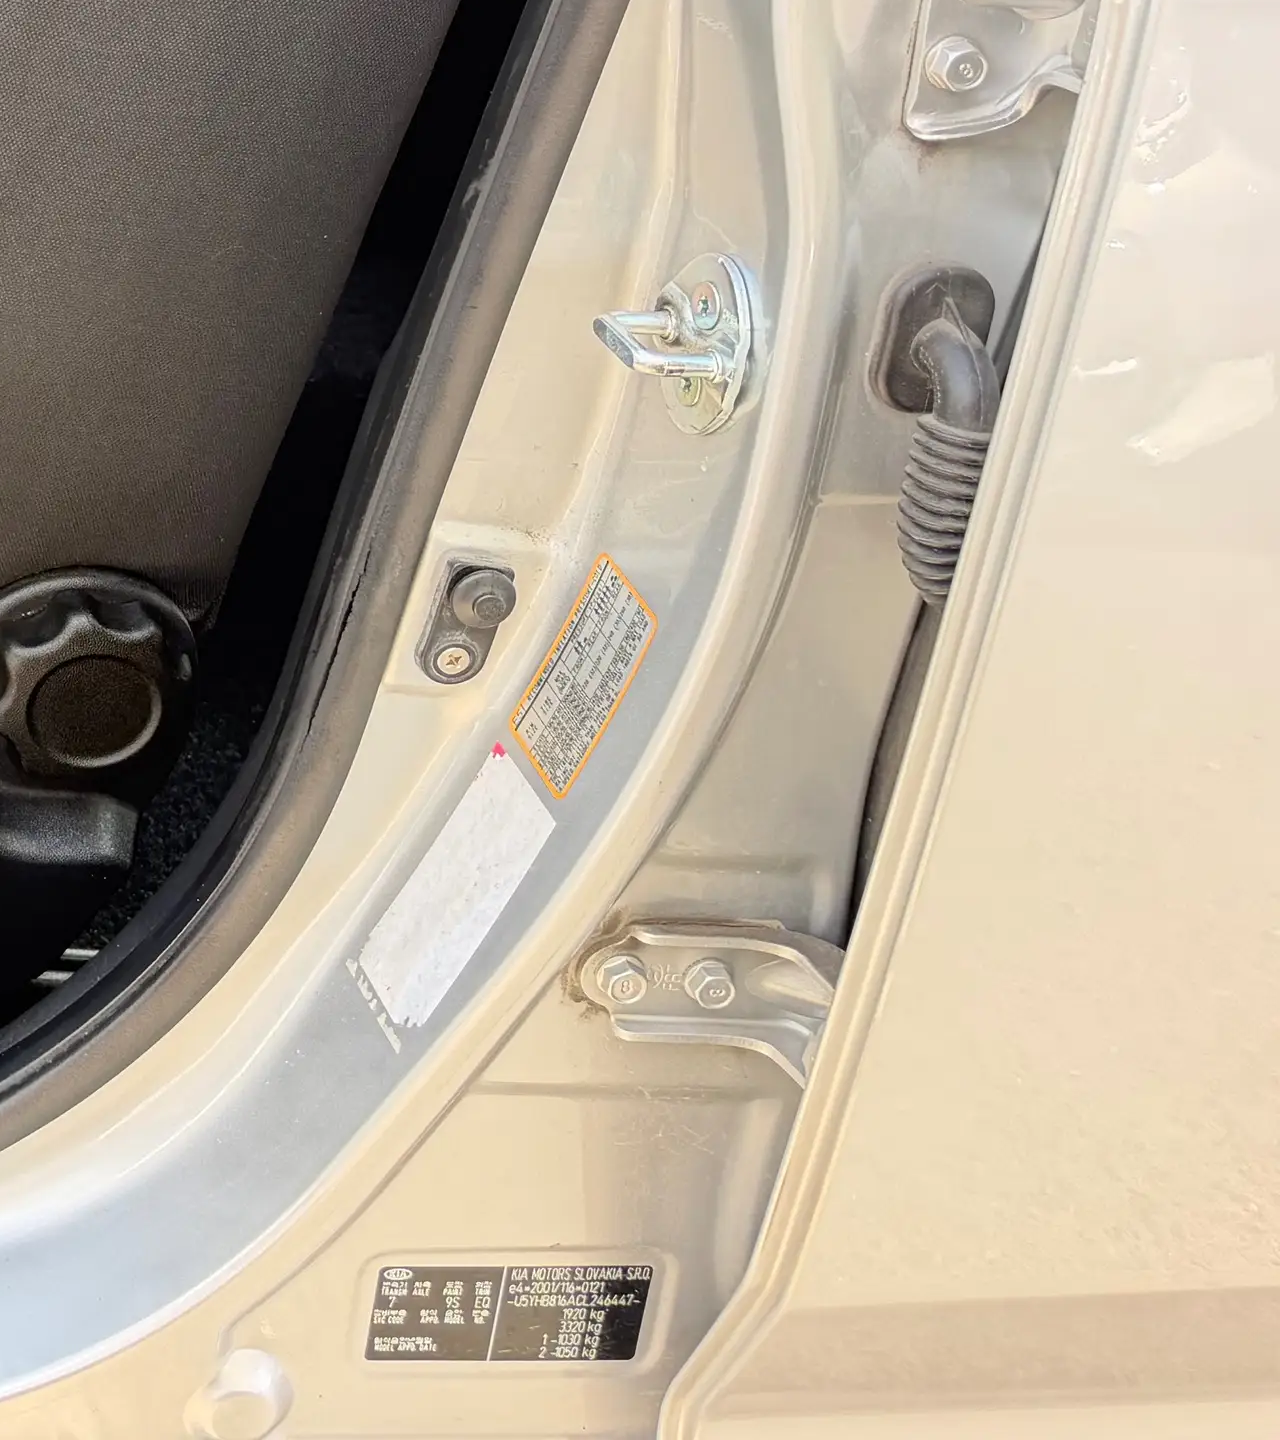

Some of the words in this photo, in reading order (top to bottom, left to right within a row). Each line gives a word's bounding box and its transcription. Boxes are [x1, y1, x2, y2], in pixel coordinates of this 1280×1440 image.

[511, 1268, 528, 1281] KIA
[532, 1268, 572, 1281] MOTORS
[574, 1268, 623, 1281] SLOVAKIA
[474, 1296, 491, 1309] EQ
[563, 1308, 586, 1320] 1920
[589, 1308, 605, 1323] kg
[559, 1321, 586, 1333] 3320
[587, 1321, 603, 1335] kg
[584, 1334, 600, 1348] kg
[538, 1346, 545, 1358] 2
[582, 1346, 597, 1360] kg
